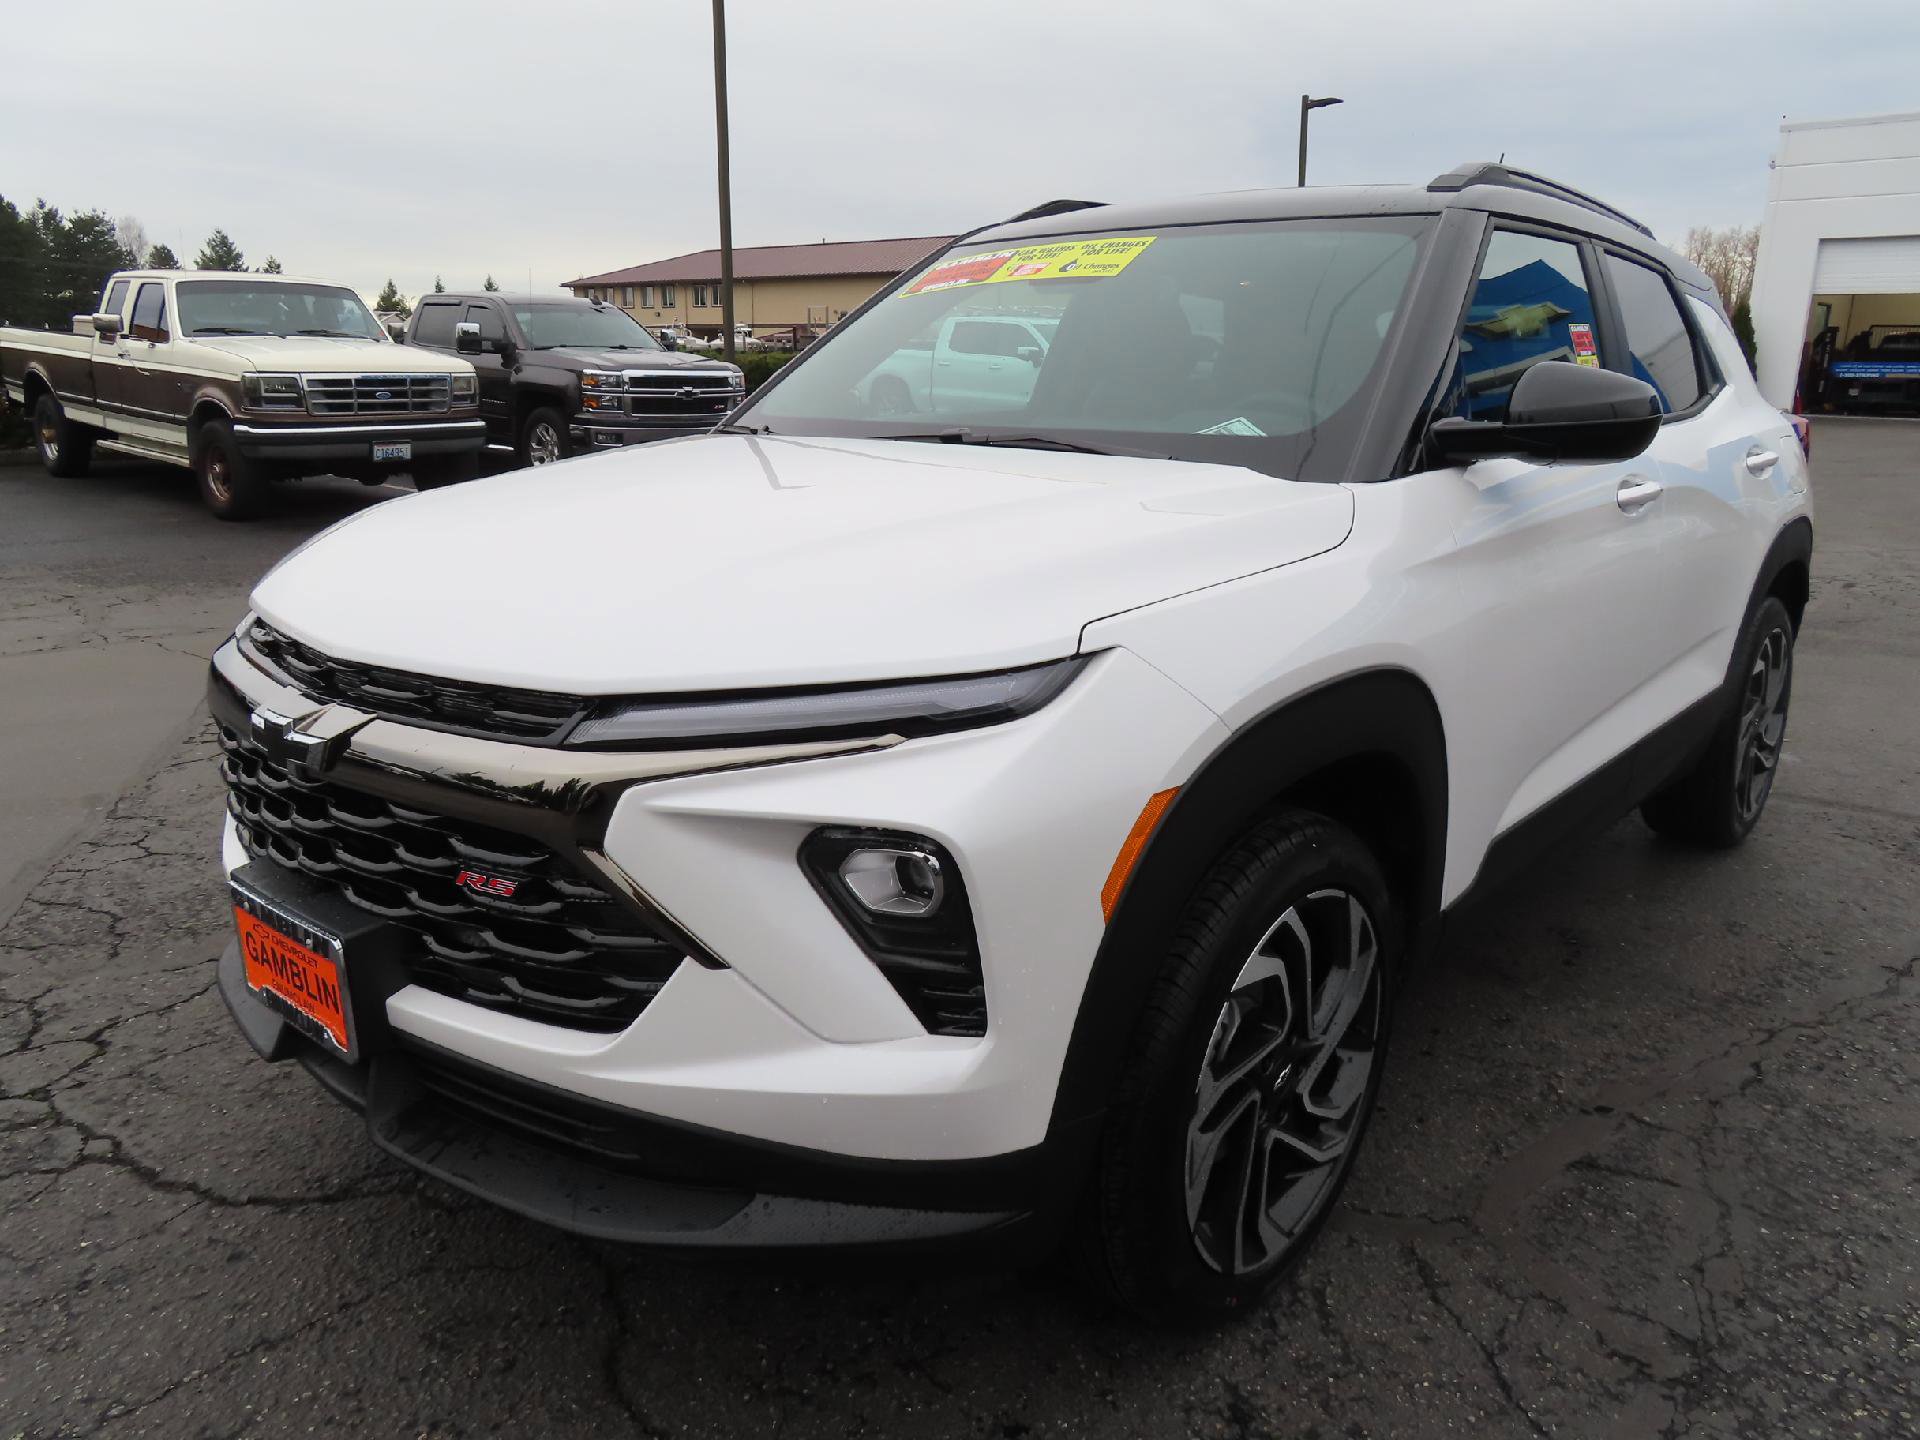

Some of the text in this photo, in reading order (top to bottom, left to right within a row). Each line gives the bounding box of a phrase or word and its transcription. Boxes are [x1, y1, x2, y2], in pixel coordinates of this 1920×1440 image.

[1081, 248, 1102, 256] FOR
[1100, 240, 1149, 249] CHANGES
[455, 870, 518, 897] RS
[271, 935, 318, 969] CHEVROLET
[245, 931, 340, 1015] GAMBLIN
